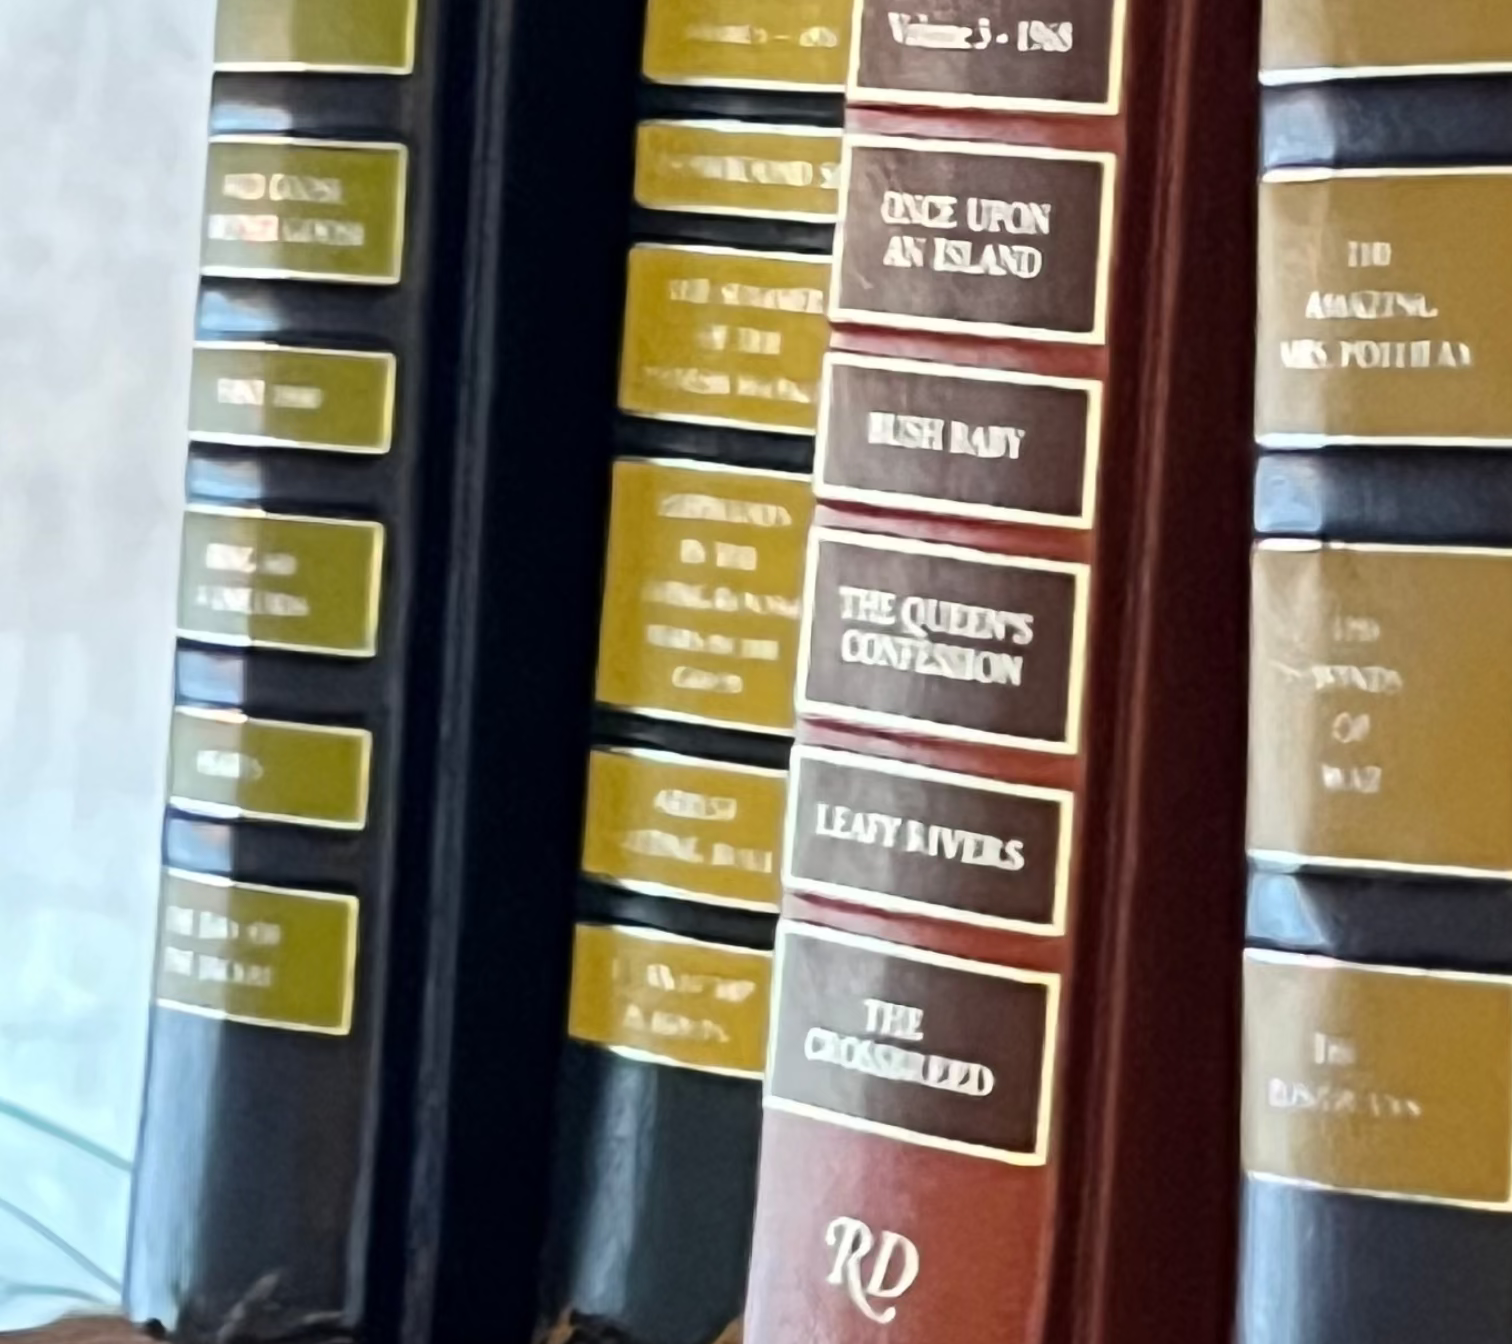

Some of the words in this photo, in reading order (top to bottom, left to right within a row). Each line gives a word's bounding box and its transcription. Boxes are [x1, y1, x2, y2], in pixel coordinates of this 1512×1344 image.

[880, 190, 957, 229] ONCE
[967, 197, 1051, 235] UPON
[883, 236, 927, 267] AN
[933, 237, 1043, 279] ISLAND
[839, 585, 896, 625] THE
[864, 998, 924, 1041] THE
[825, 1216, 920, 1324] RD
